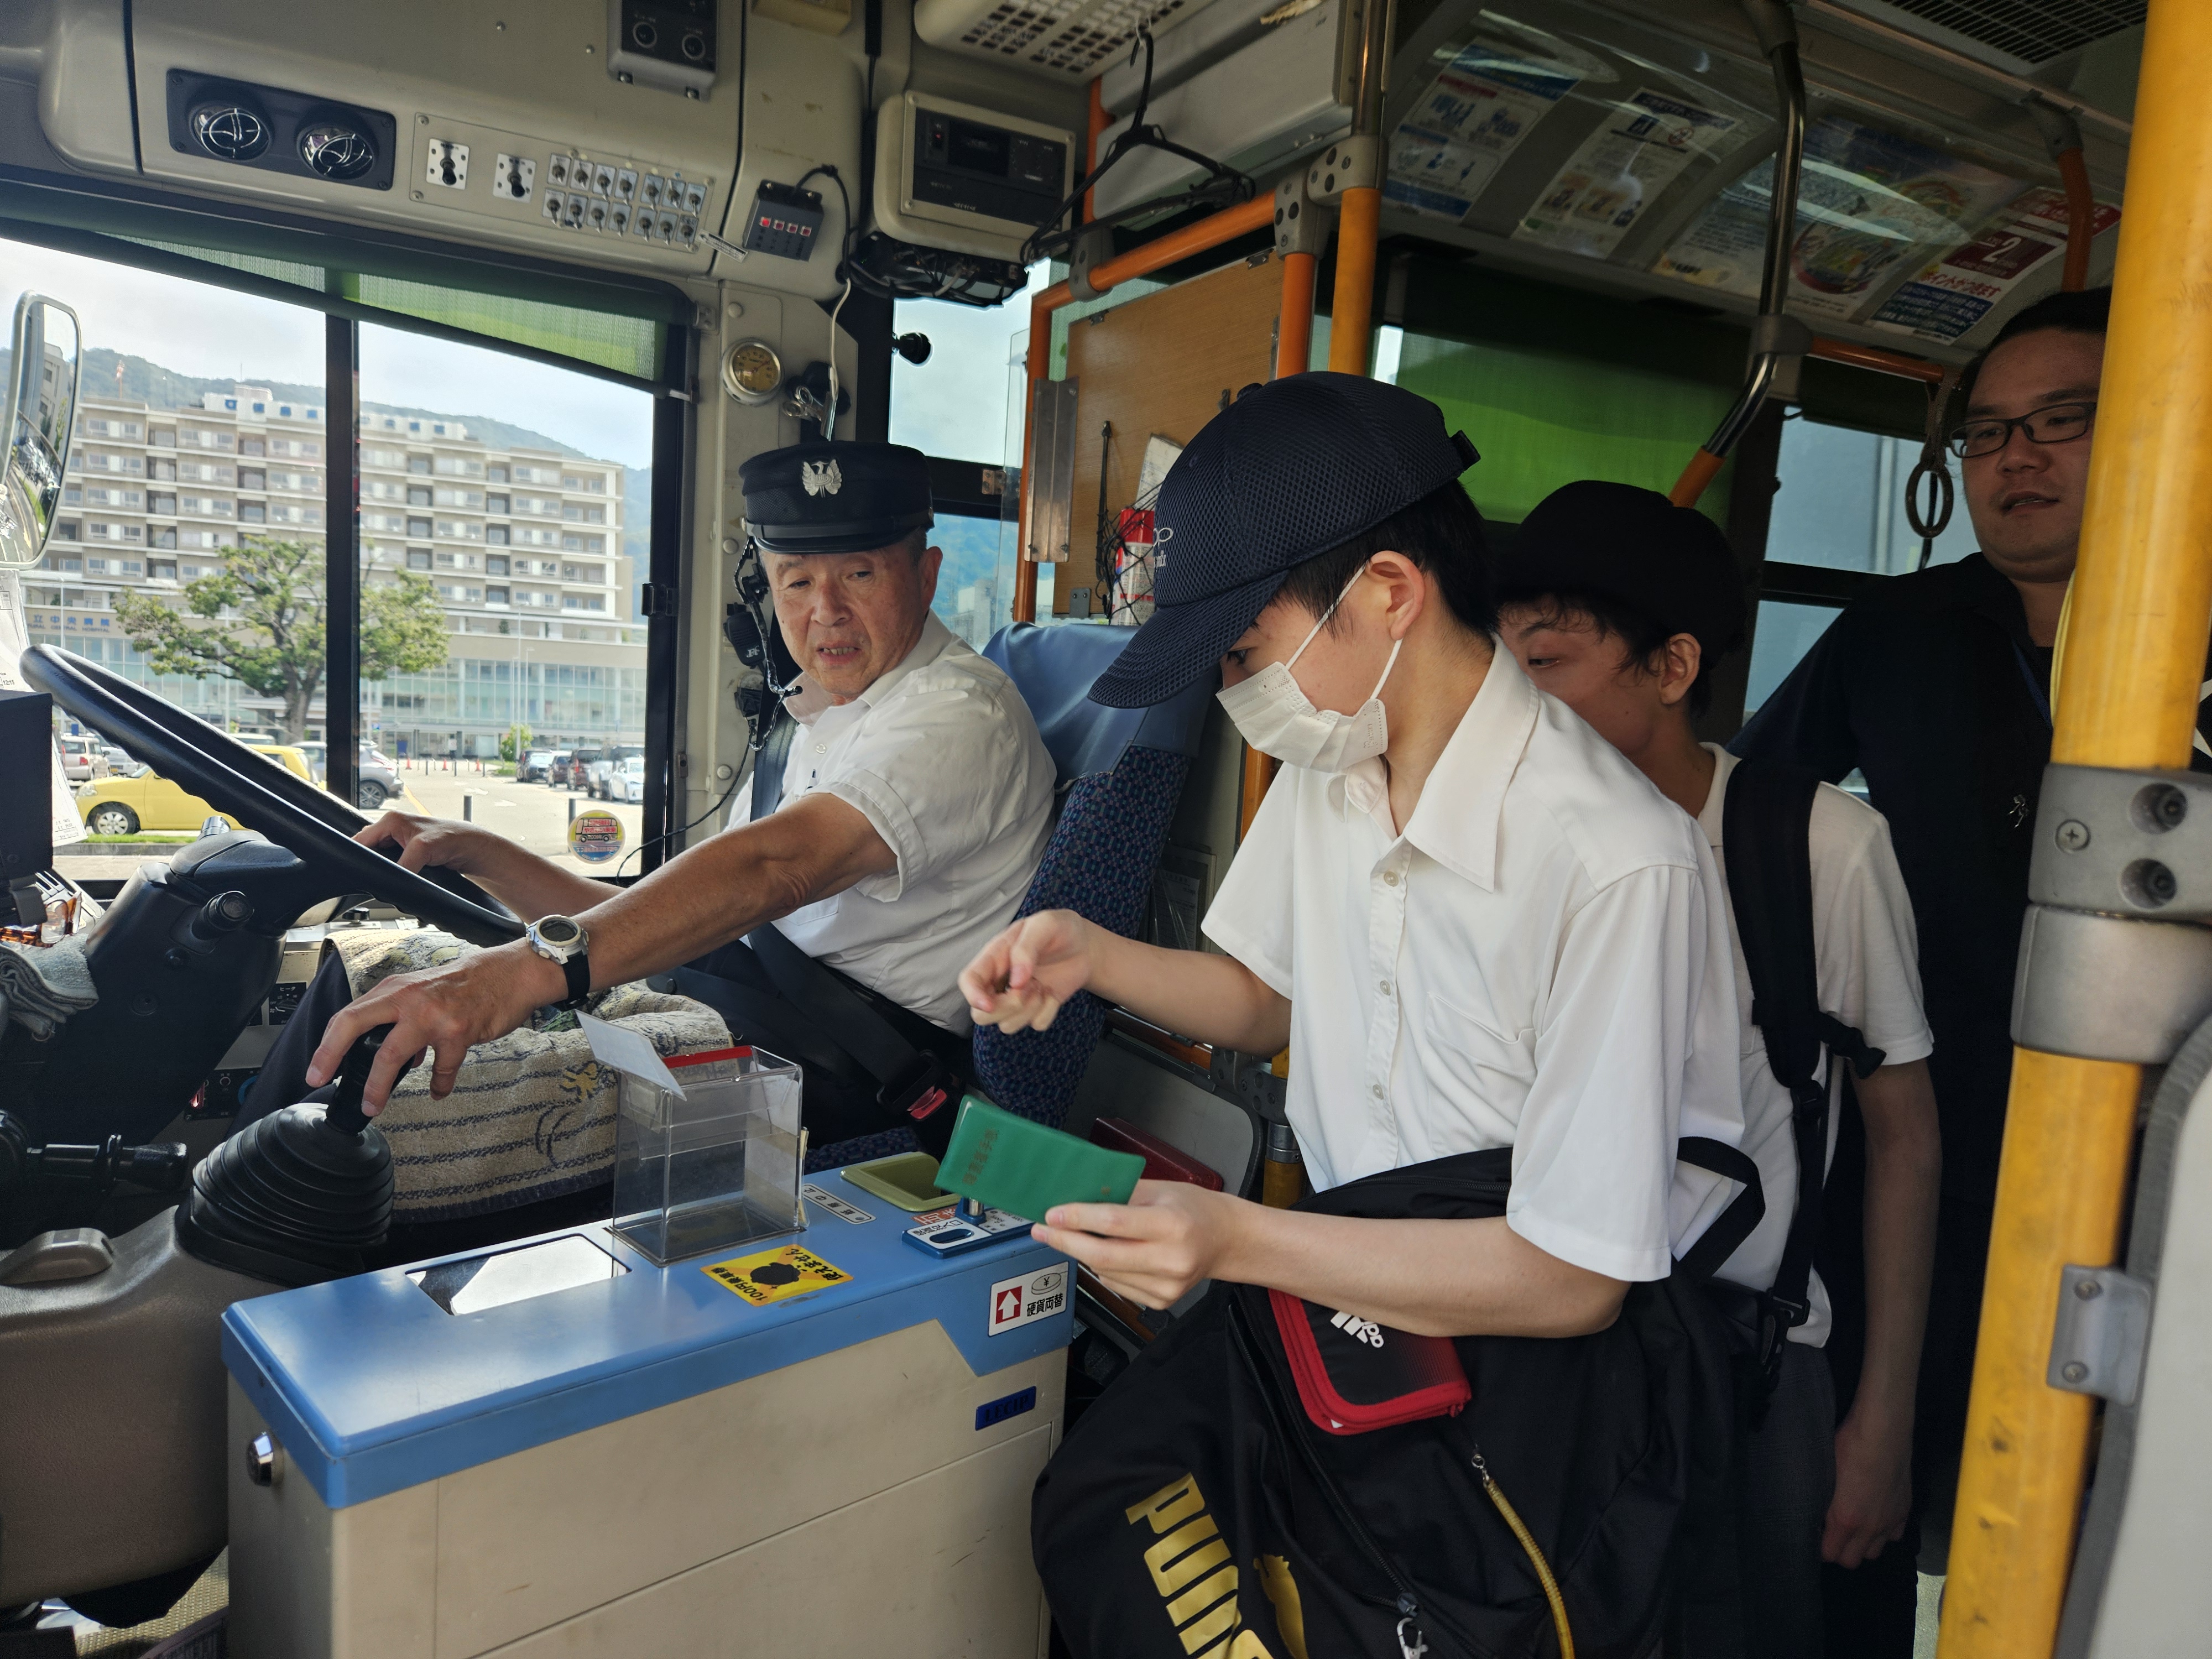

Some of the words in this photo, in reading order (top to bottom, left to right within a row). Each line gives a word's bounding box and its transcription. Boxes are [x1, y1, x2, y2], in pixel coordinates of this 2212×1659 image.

[786, 1247, 843, 1281] 使えません
[1026, 1293, 1064, 1317] 硬貨両替
[985, 1395, 1029, 1423] LECIP
